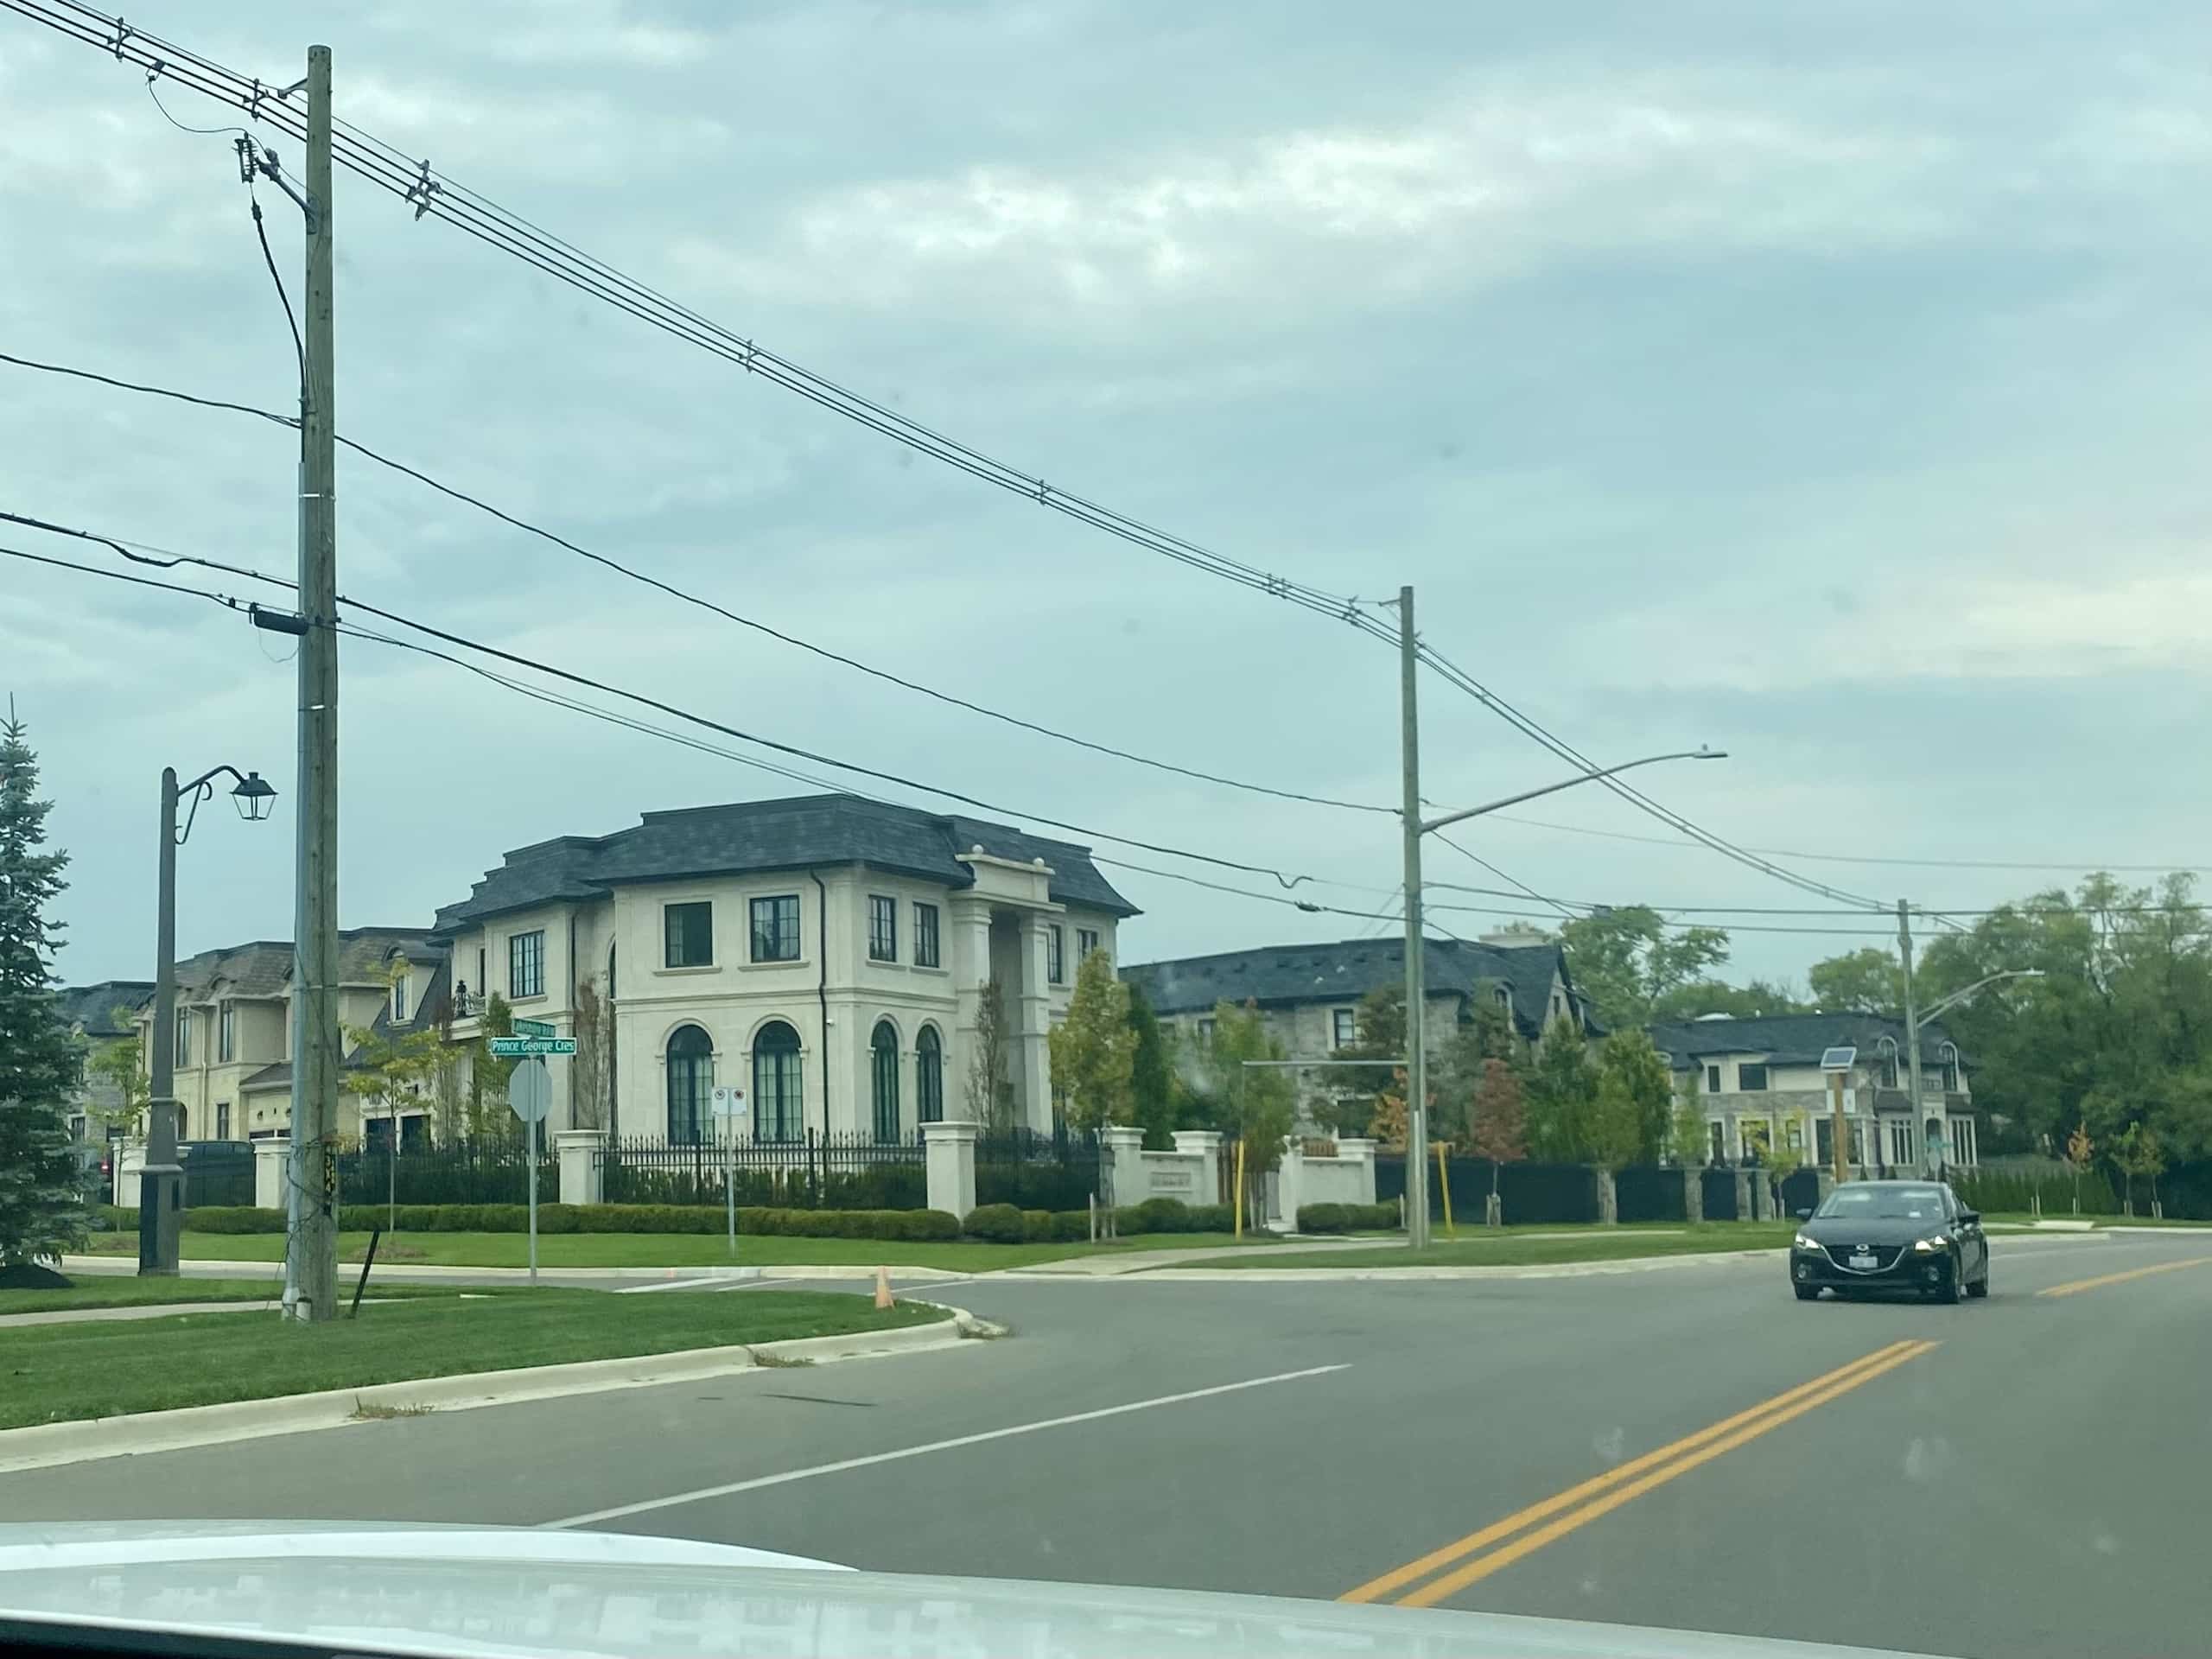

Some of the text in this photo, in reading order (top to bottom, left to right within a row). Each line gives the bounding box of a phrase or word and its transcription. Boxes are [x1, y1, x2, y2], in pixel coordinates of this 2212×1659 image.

[493, 1040, 575, 1053] Prince George Cres
